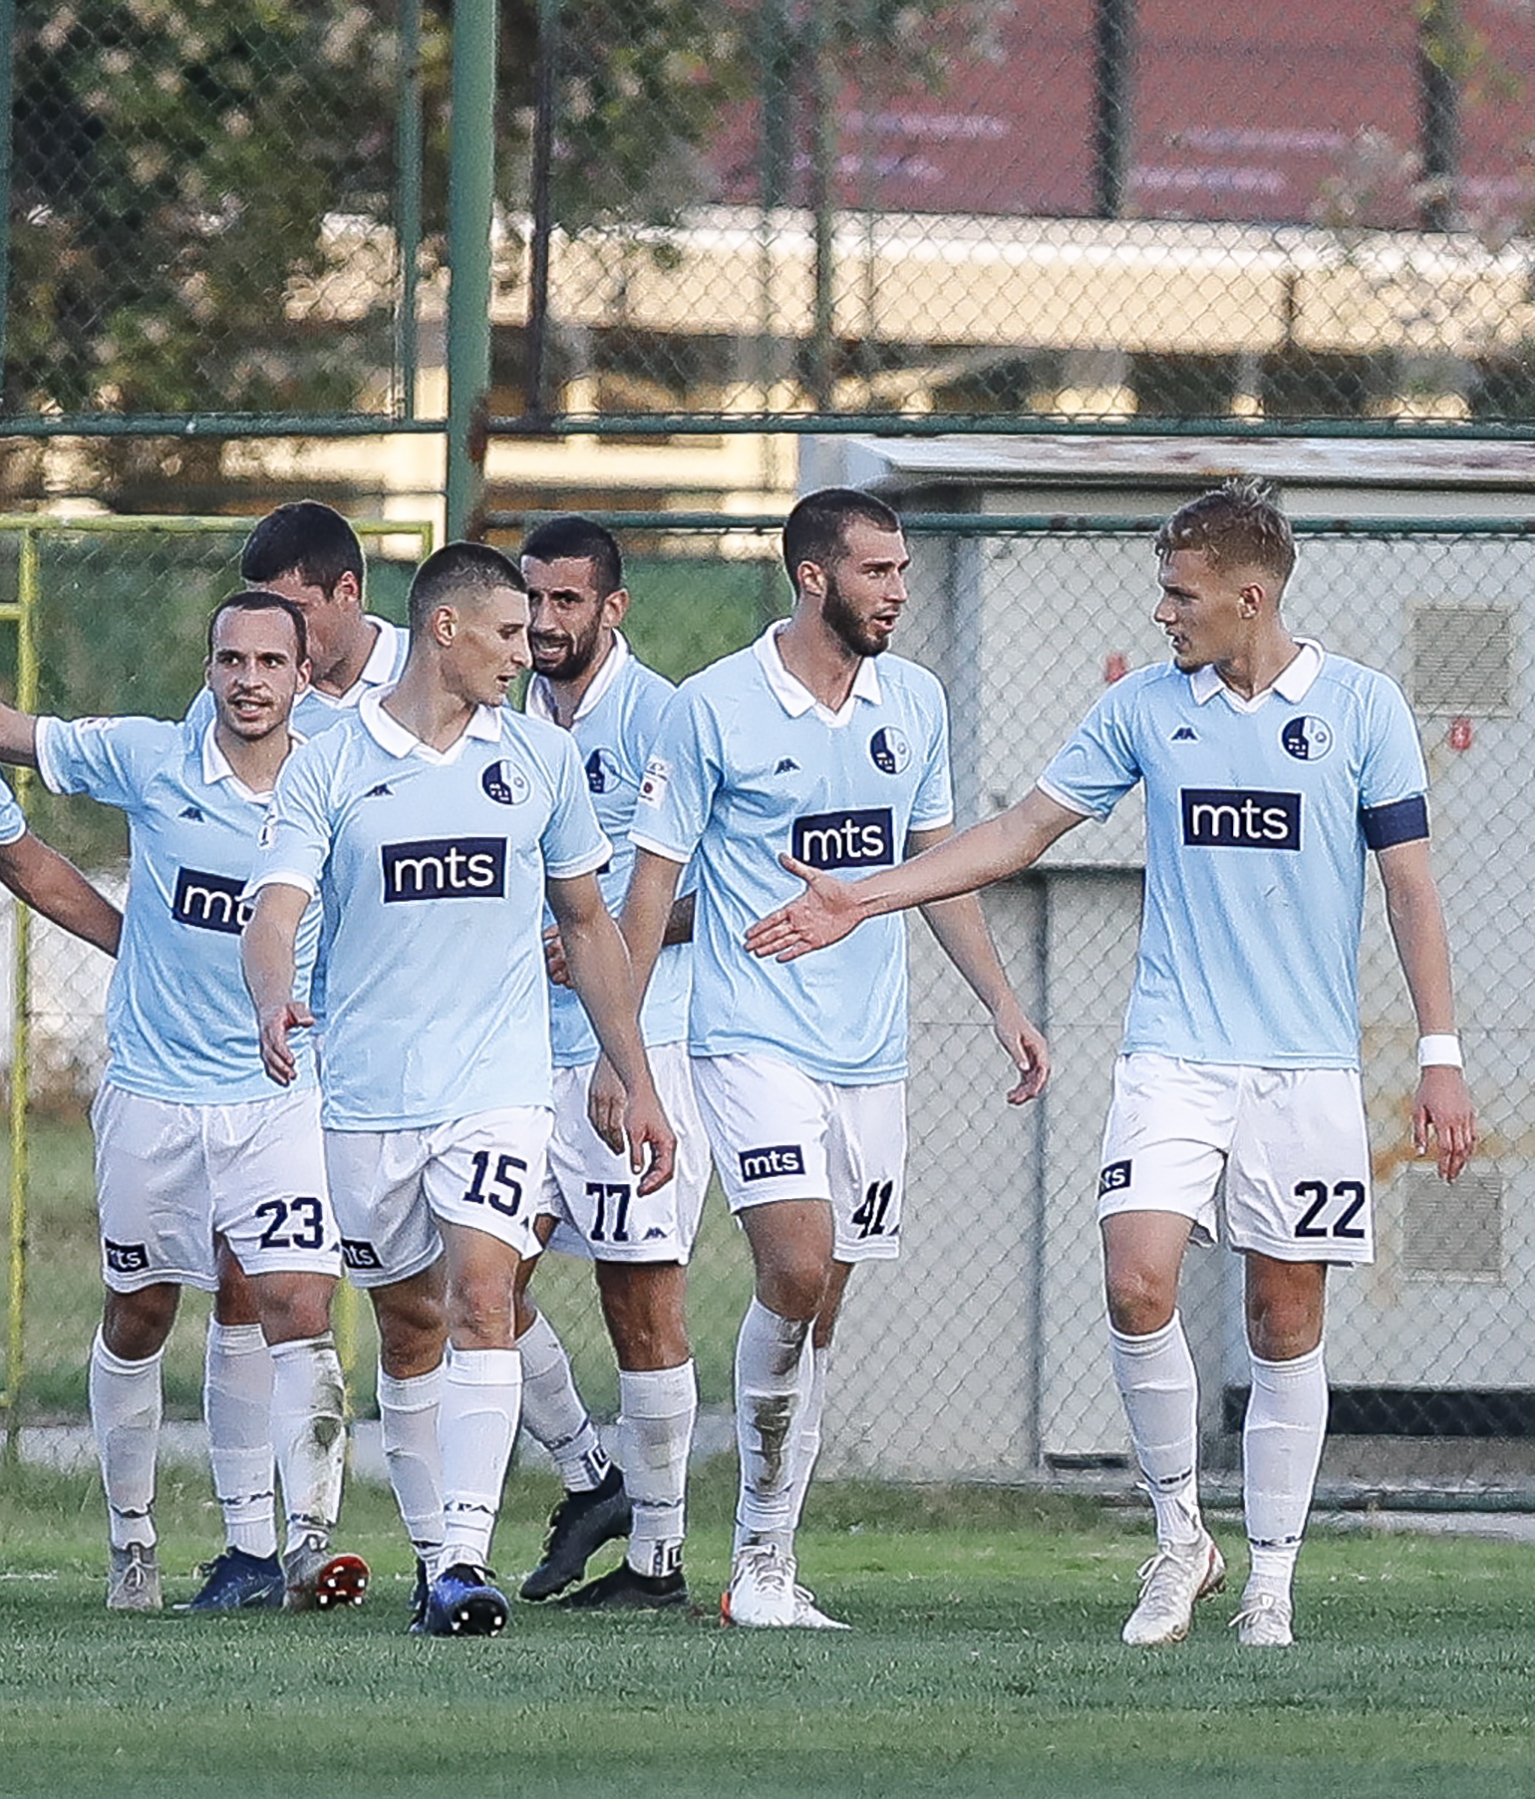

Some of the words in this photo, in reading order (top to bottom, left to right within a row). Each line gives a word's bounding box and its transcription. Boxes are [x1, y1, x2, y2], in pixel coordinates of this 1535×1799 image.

[803, 819, 884, 862] mts
[1192, 798, 1289, 840] mts
[395, 847, 494, 892] mts
[183, 885, 256, 926] mt
[463, 1150, 527, 1217] 15
[744, 1150, 799, 1177] mts
[257, 1197, 324, 1250] 23
[586, 1182, 632, 1242] 77
[851, 1180, 893, 1240] 41
[1294, 1180, 1365, 1239] 22
